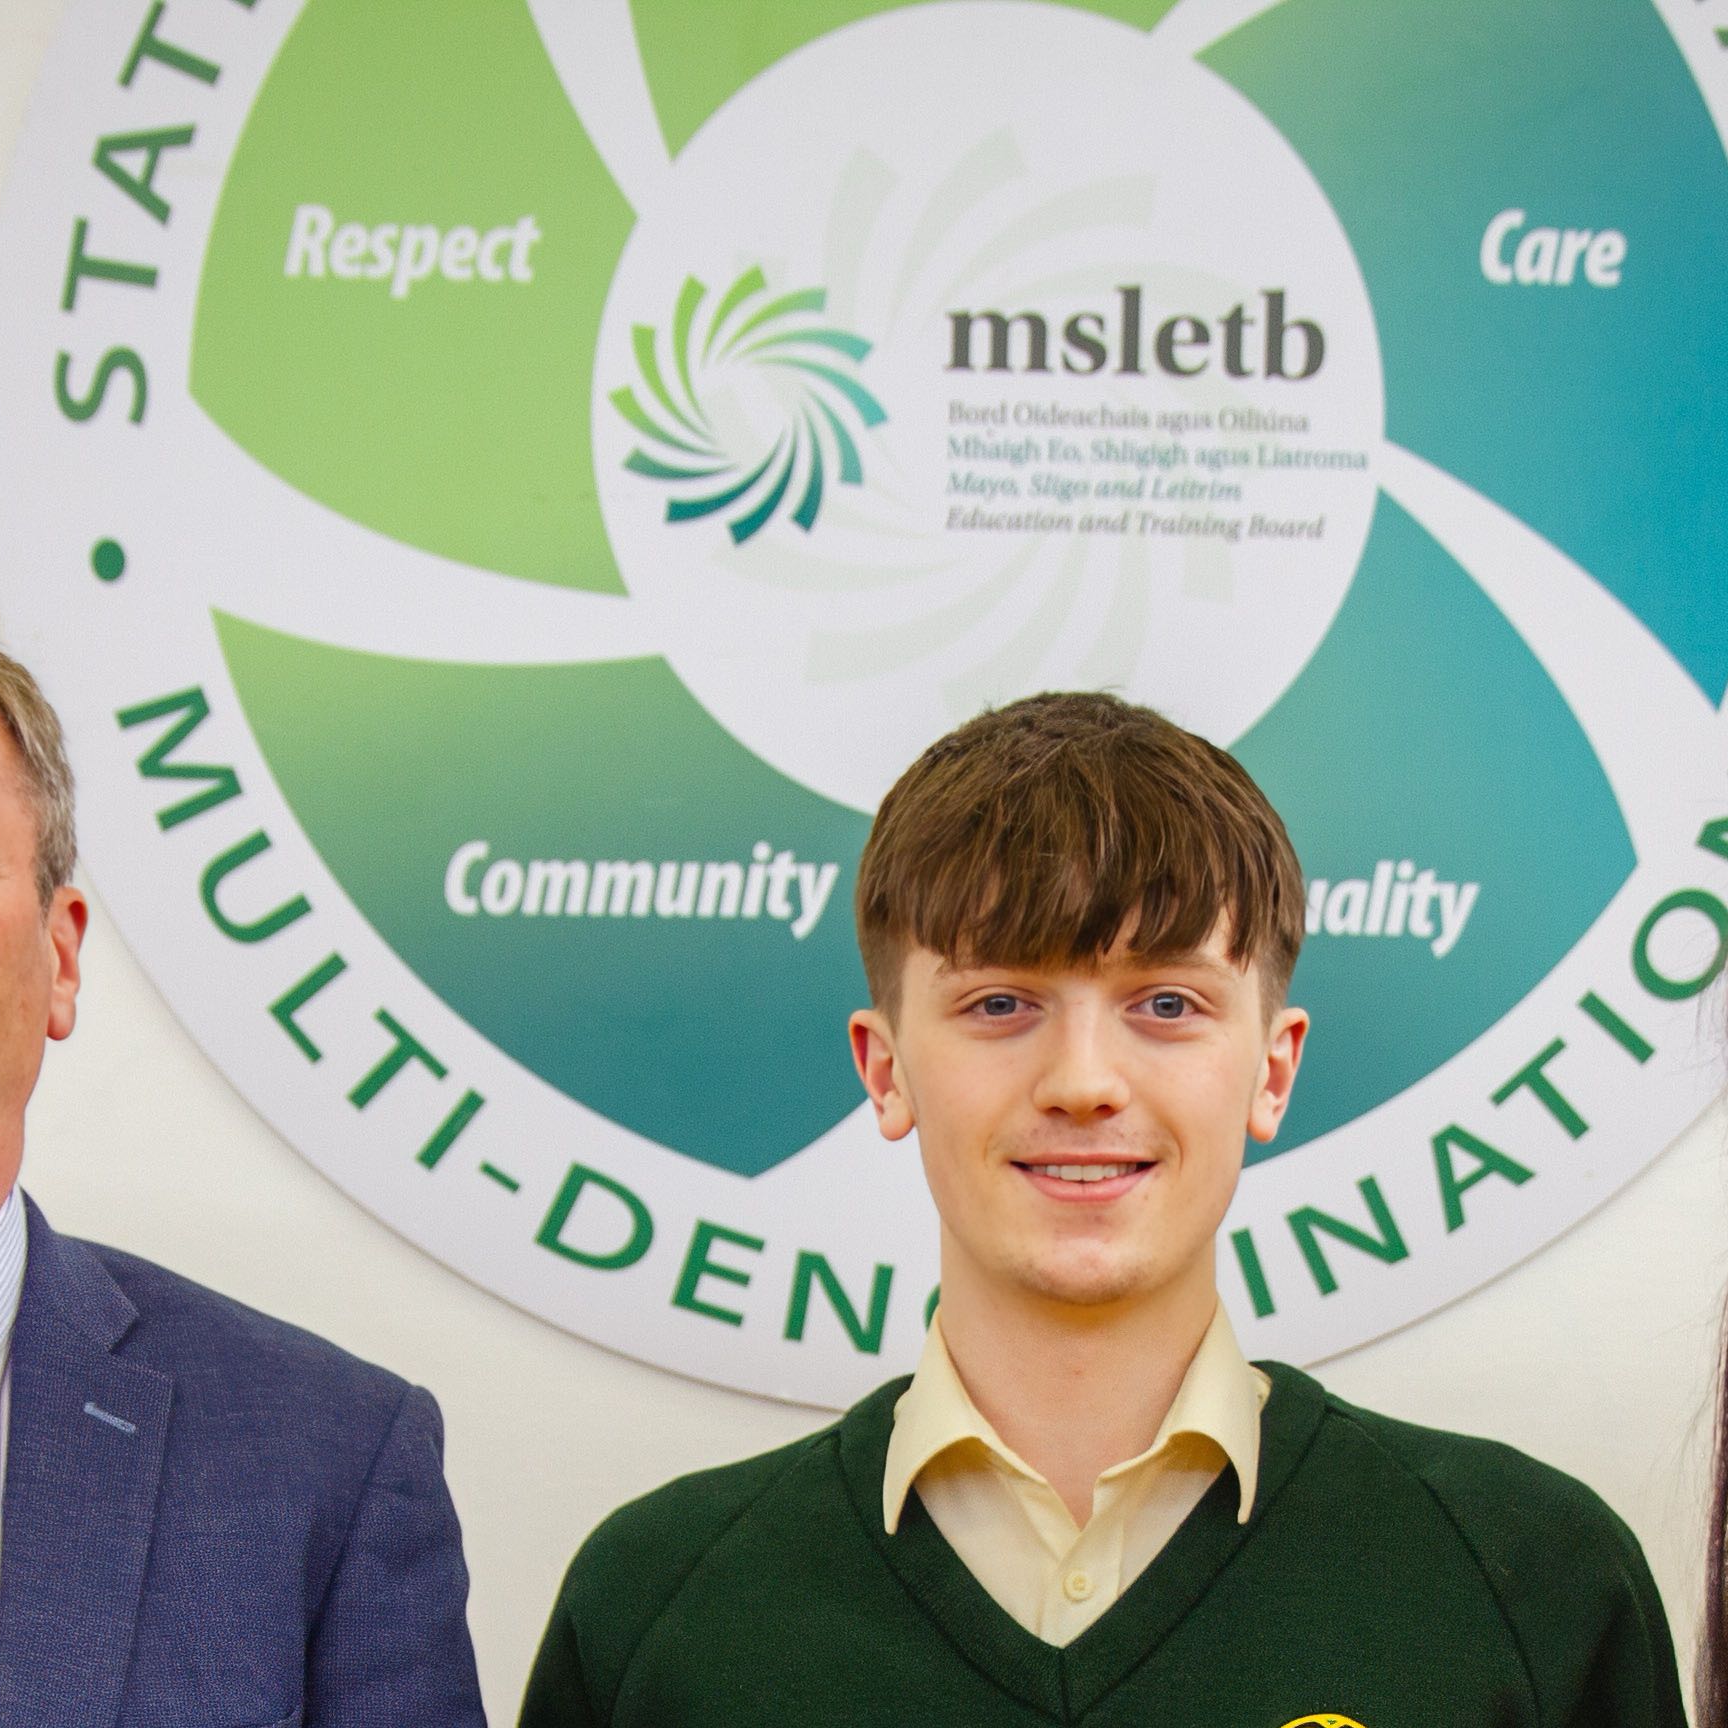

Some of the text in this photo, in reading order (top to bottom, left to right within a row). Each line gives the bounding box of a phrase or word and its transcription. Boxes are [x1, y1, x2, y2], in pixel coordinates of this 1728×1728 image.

[54, 0, 257, 425] STAT
[283, 203, 542, 298] Respect
[1479, 207, 1627, 288] Care
[945, 284, 1327, 380] msletb
[948, 399, 1009, 426] Bord
[1156, 408, 1213, 434] agus
[946, 504, 1327, 542] Education and Training Board
[1094, 474, 1145, 500] and
[444, 841, 839, 940] Community
